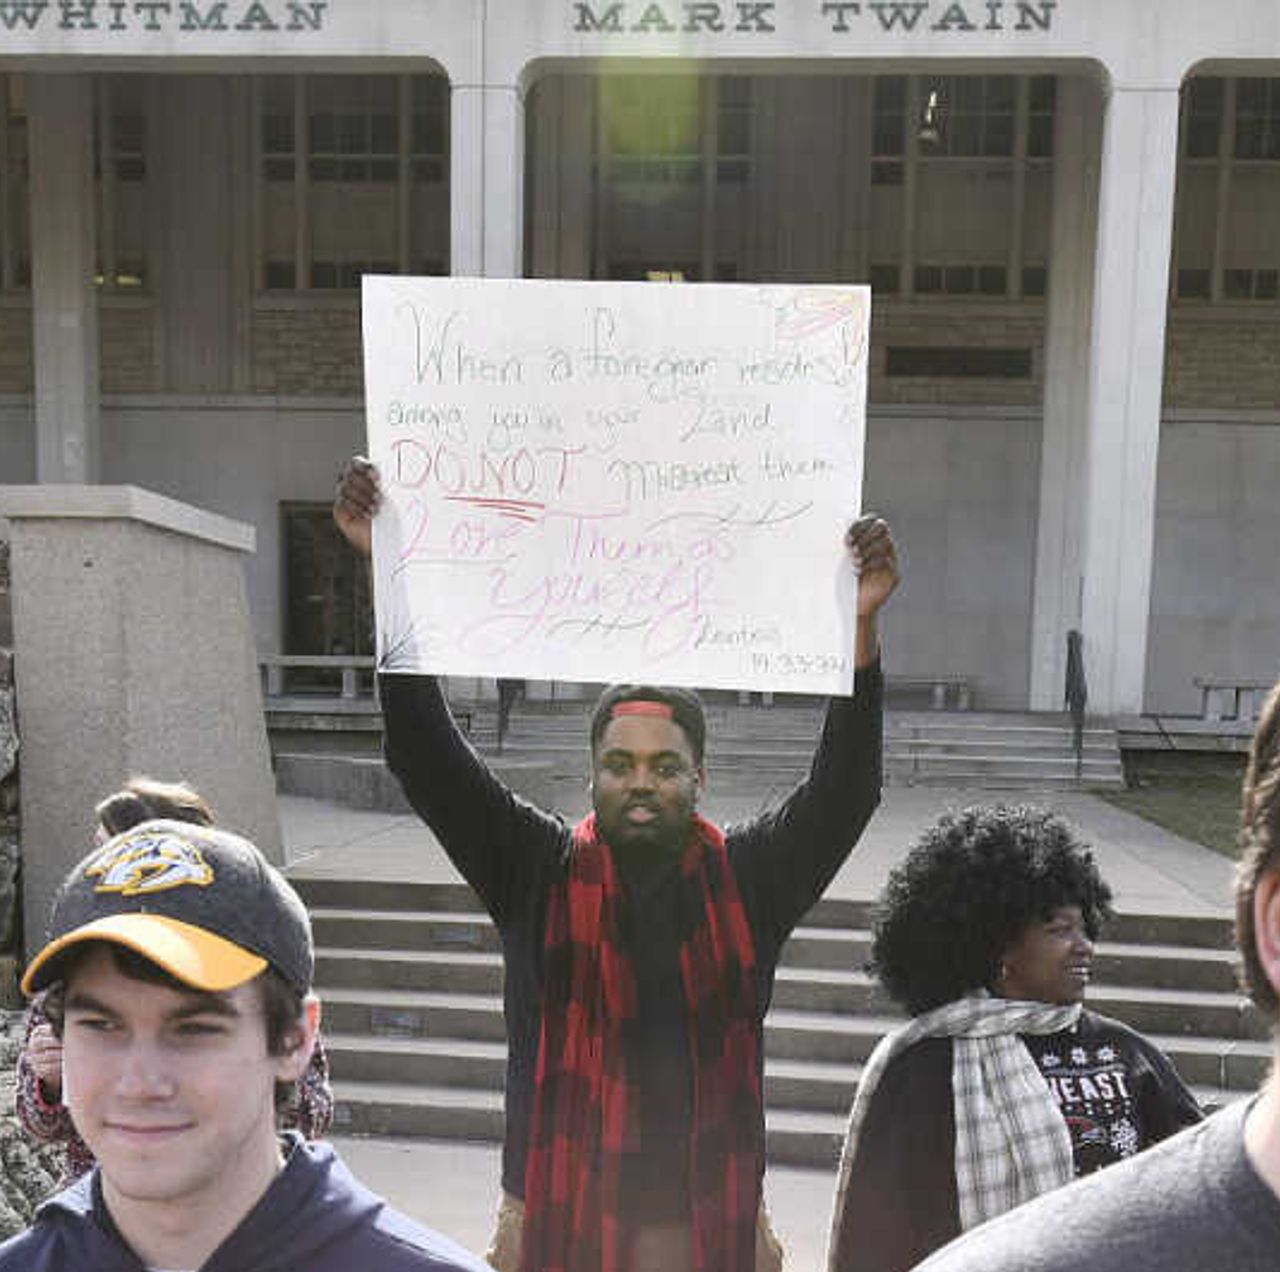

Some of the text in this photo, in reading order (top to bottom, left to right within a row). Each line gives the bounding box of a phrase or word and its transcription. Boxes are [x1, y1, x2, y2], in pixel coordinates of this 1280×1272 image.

[574, 2, 1057, 32] MARK TWAIN
[395, 302, 524, 384] When
[391, 440, 587, 494] DO NOT
